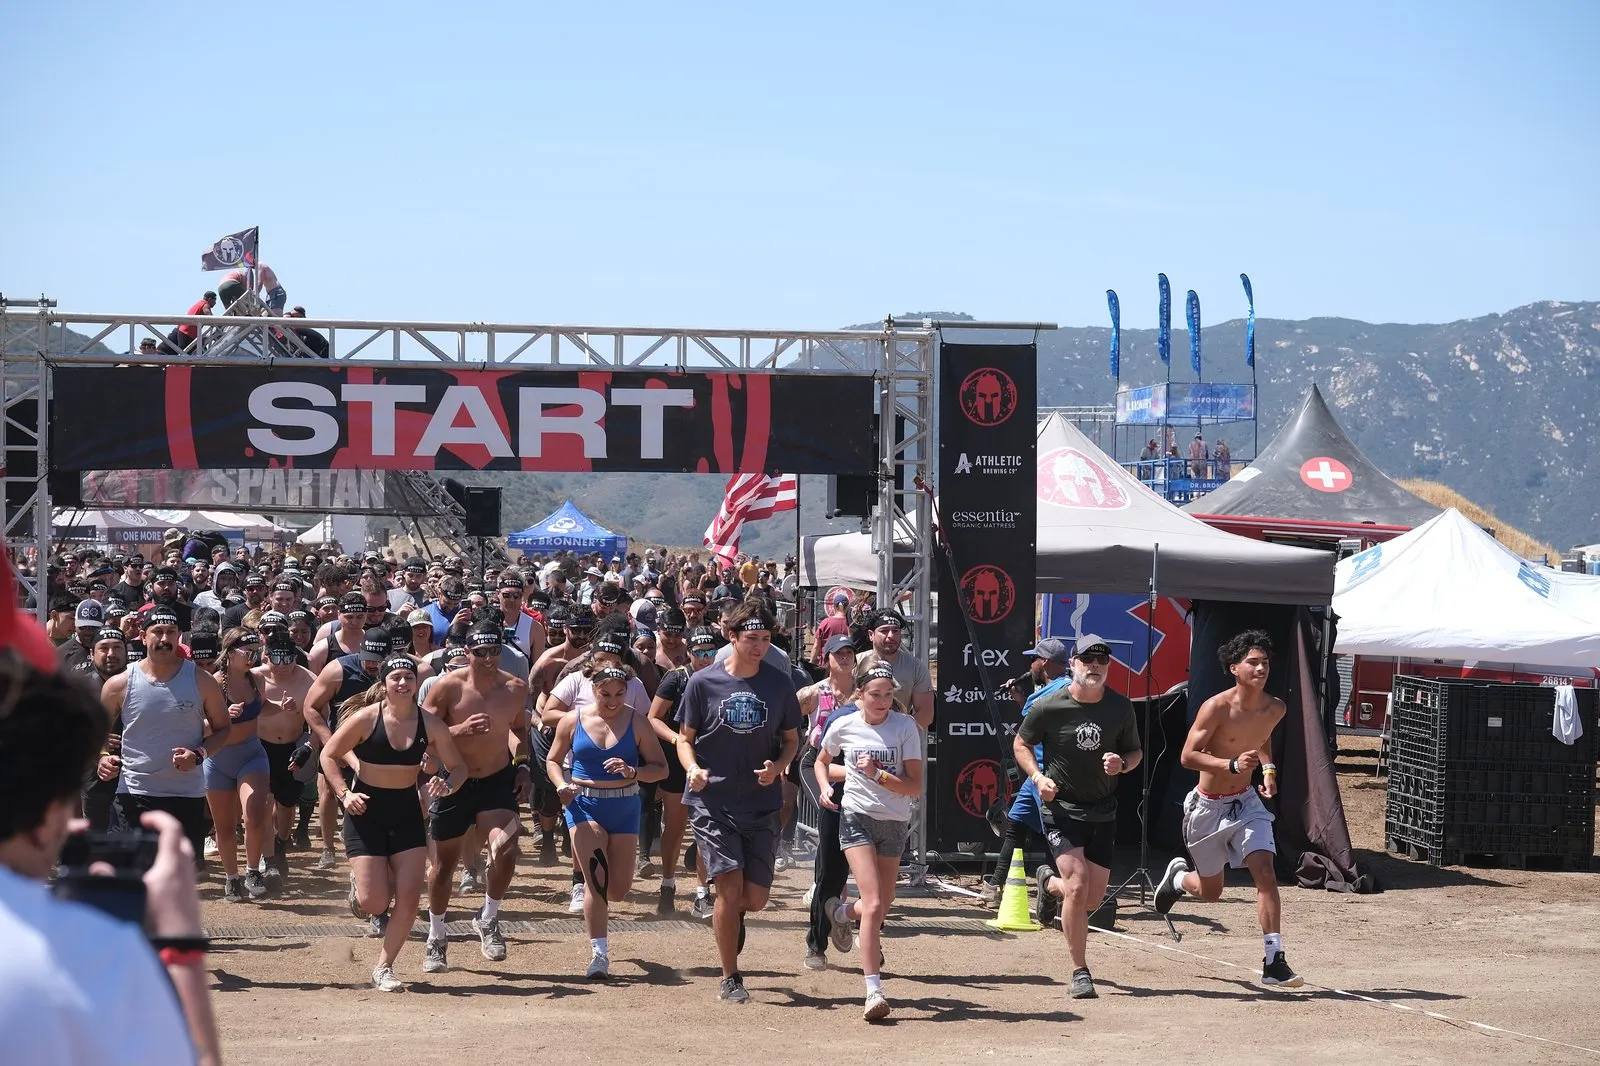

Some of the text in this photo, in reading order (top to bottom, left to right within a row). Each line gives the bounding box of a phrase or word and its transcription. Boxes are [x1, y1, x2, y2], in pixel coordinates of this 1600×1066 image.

[247, 381, 694, 459] START
[975, 455, 1022, 466] ATHLETIC
[210, 469, 385, 508] SPARTAN
[952, 509, 1015, 522] essentia
[123, 531, 139, 542] ONE
[140, 531, 161, 542] MORE
[517, 537, 606, 548] DR. BRONNER'S
[962, 643, 1010, 668] fex
[1542, 675, 1568, 686] 26814
[726, 709, 760, 722] TRIFECTA
